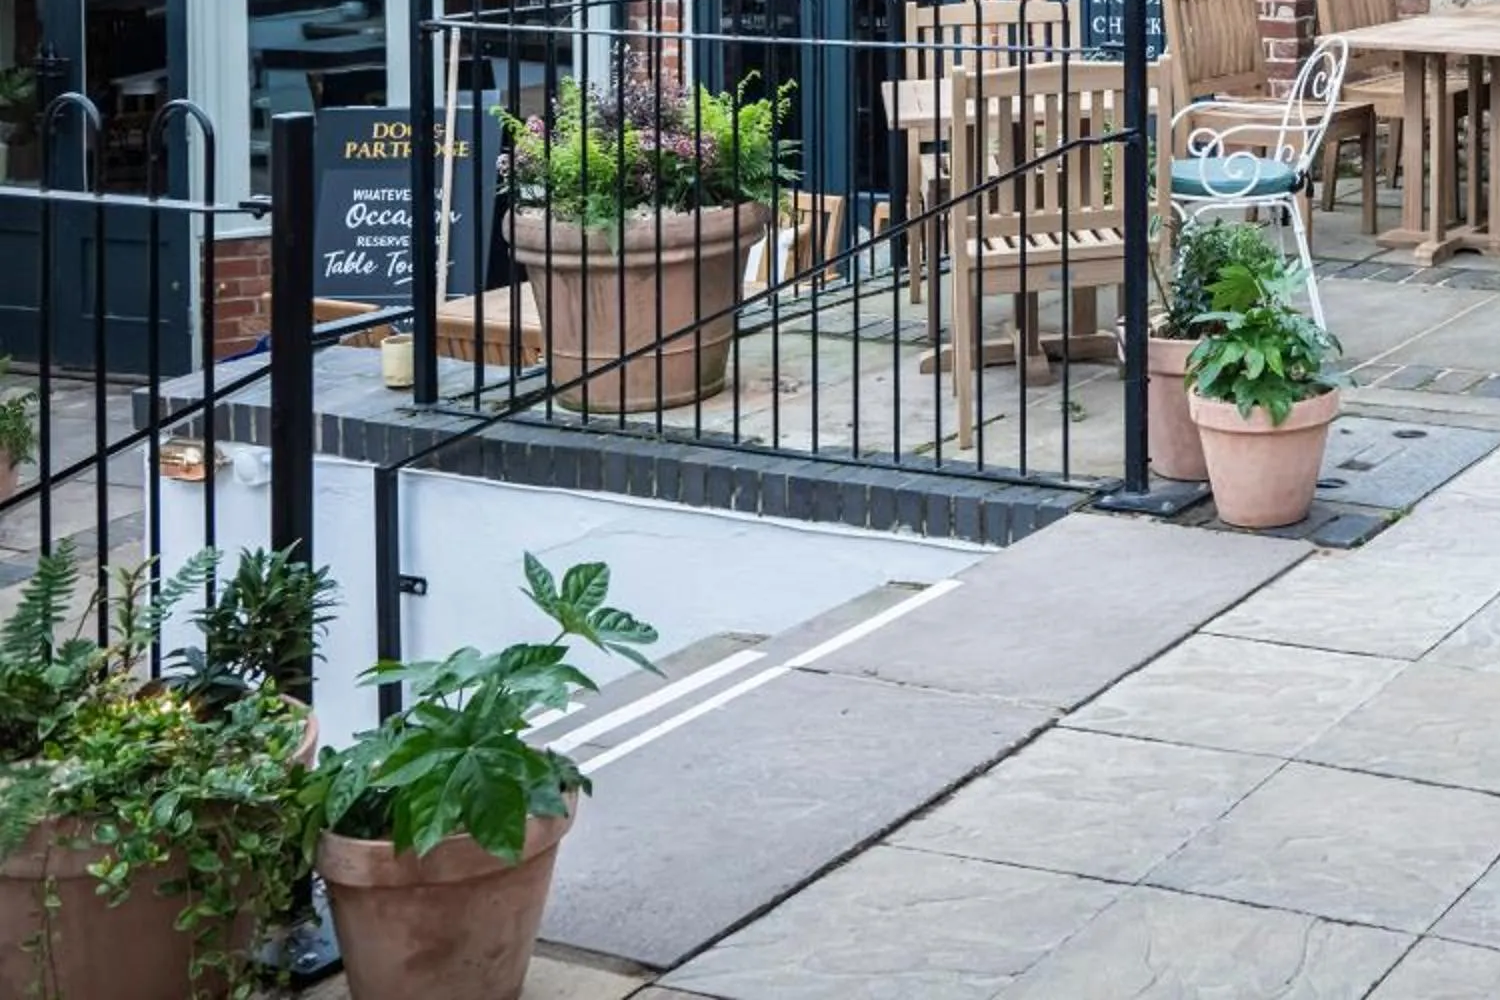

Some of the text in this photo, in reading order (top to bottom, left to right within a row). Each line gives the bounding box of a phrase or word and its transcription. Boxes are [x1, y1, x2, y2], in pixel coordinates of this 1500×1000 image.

[372, 121, 412, 138] DO
[353, 189, 412, 201] WHATEVE
[324, 250, 379, 278] Table
